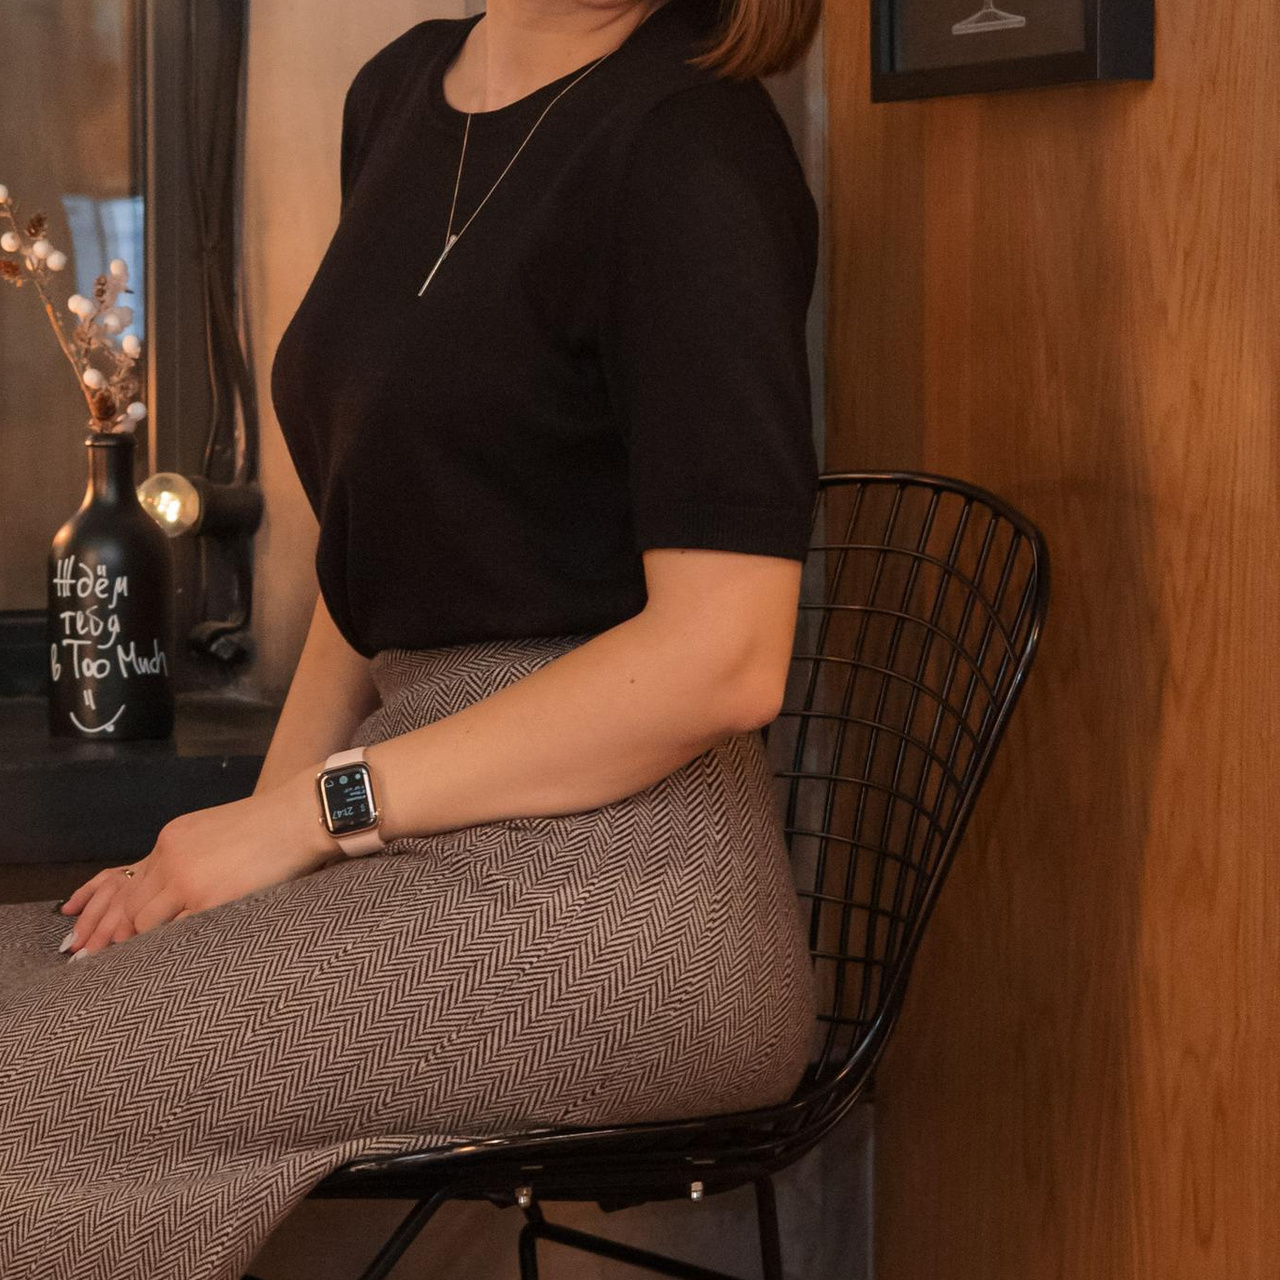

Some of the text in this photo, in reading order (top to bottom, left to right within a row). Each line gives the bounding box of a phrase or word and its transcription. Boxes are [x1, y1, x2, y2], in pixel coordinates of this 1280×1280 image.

[52, 554, 129, 608] Ждём
[60, 605, 121, 650] тебя
[62, 638, 110, 680] Too
[116, 639, 169, 679] Much
